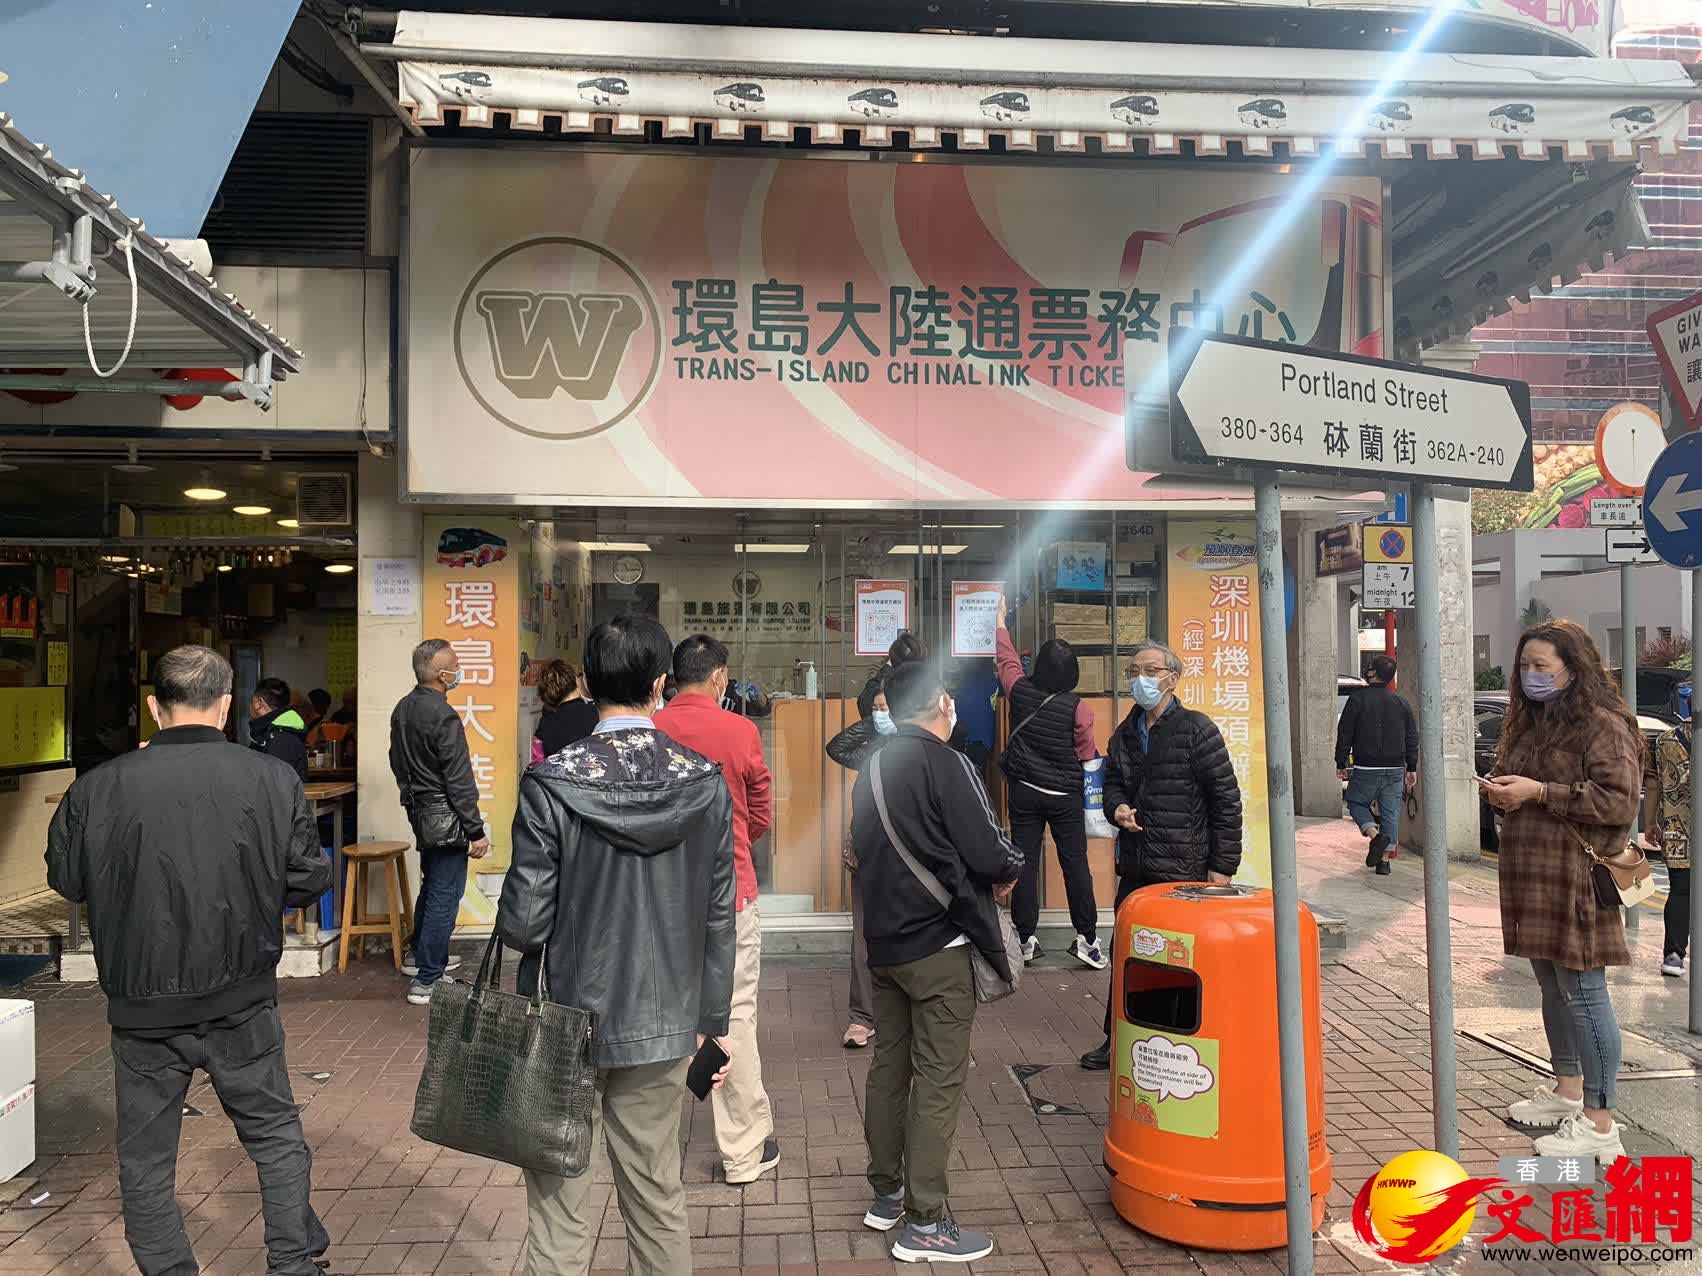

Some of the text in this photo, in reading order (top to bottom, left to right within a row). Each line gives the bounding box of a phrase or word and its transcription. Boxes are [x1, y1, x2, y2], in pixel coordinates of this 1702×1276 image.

[671, 278, 1296, 361] 環島大陸通票務中心
[476, 291, 643, 400] W
[673, 357, 870, 383] TRANS-ISLAND
[887, 361, 1031, 387] CHINALINK
[1281, 362, 1449, 414] Portland Street
[1220, 416, 1304, 445] 380-364
[1323, 420, 1417, 465] 砵蘭街
[1426, 439, 1505, 467] 362A-240
[1593, 501, 1616, 510] Length
[1600, 511, 1627, 521] 車長逾
[1374, 572, 1391, 581] 上午
[1400, 566, 1410, 581] 7
[1367, 588, 1398, 598] midnight
[1401, 591, 1415, 606] 12
[1374, 597, 1391, 606] 午夜
[1137, 1061, 1162, 1073] Discarding
[1162, 1067, 1179, 1076] refuse
[1157, 1074, 1183, 1084] container
